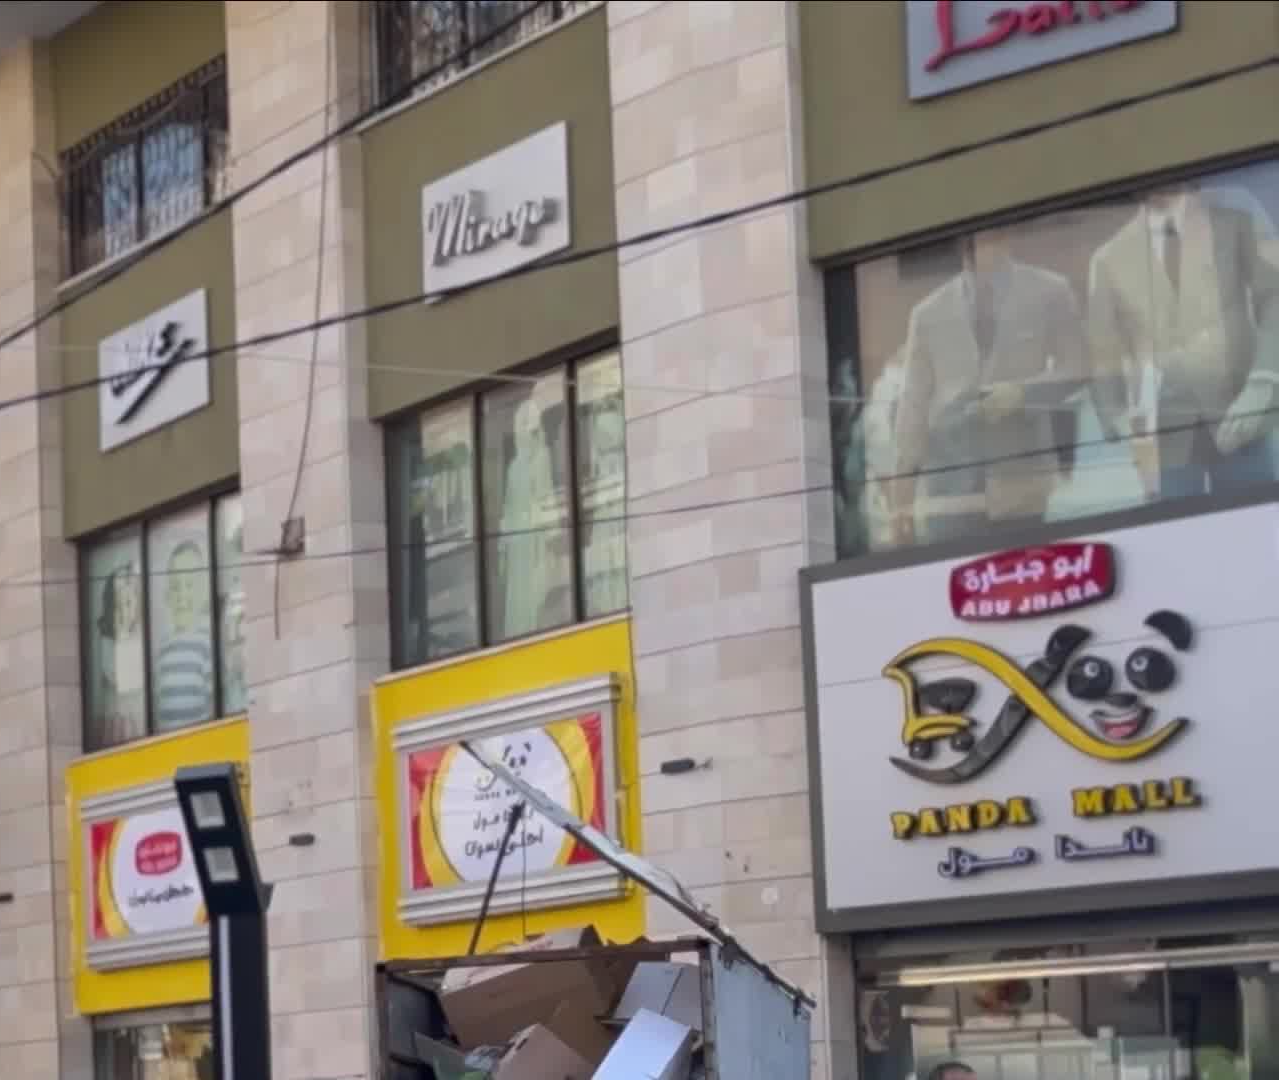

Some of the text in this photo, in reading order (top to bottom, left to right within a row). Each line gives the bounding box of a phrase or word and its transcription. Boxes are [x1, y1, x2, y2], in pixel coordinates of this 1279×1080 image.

[962, 560, 1045, 593] جبارة
[961, 599, 1011, 617] ABU
[891, 777, 1201, 840] PANDA MALL
[938, 847, 1036, 878] مول
